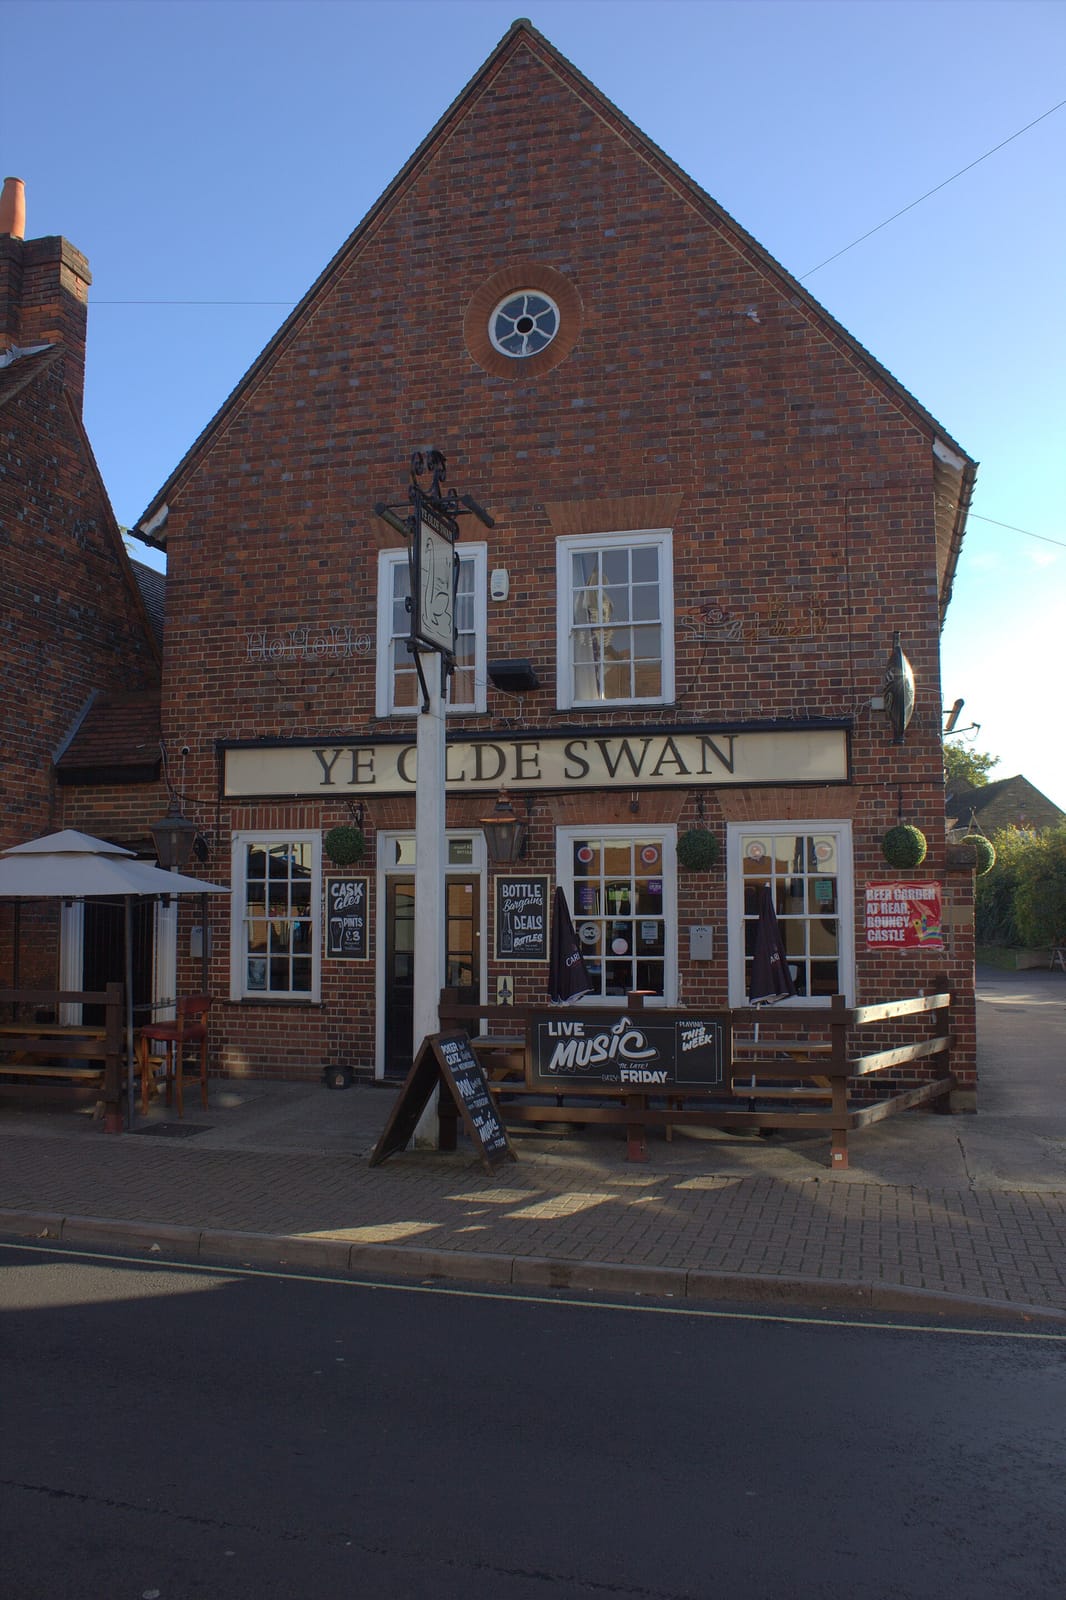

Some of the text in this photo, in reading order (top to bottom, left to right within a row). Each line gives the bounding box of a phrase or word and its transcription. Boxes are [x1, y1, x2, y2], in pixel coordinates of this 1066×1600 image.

[313, 748, 376, 785] YE
[564, 735, 739, 779] SWAN
[331, 883, 363, 896] CASK
[503, 884, 541, 897] BOTTLE
[866, 889, 935, 900] BEER GARDEN
[503, 896, 543, 912] Bargains
[867, 903, 879, 914] AT
[343, 917, 363, 927] PINTS
[514, 915, 542, 929] DEALS
[867, 916, 910, 928] BOUNCY
[514, 933, 543, 947] BOTTLES
[868, 929, 905, 941] CASTLE
[548, 1022, 585, 1036] LIVE
[681, 1027, 706, 1040] THIS
[682, 1035, 712, 1051] WEEK
[621, 1070, 668, 1083] FRIDAY
